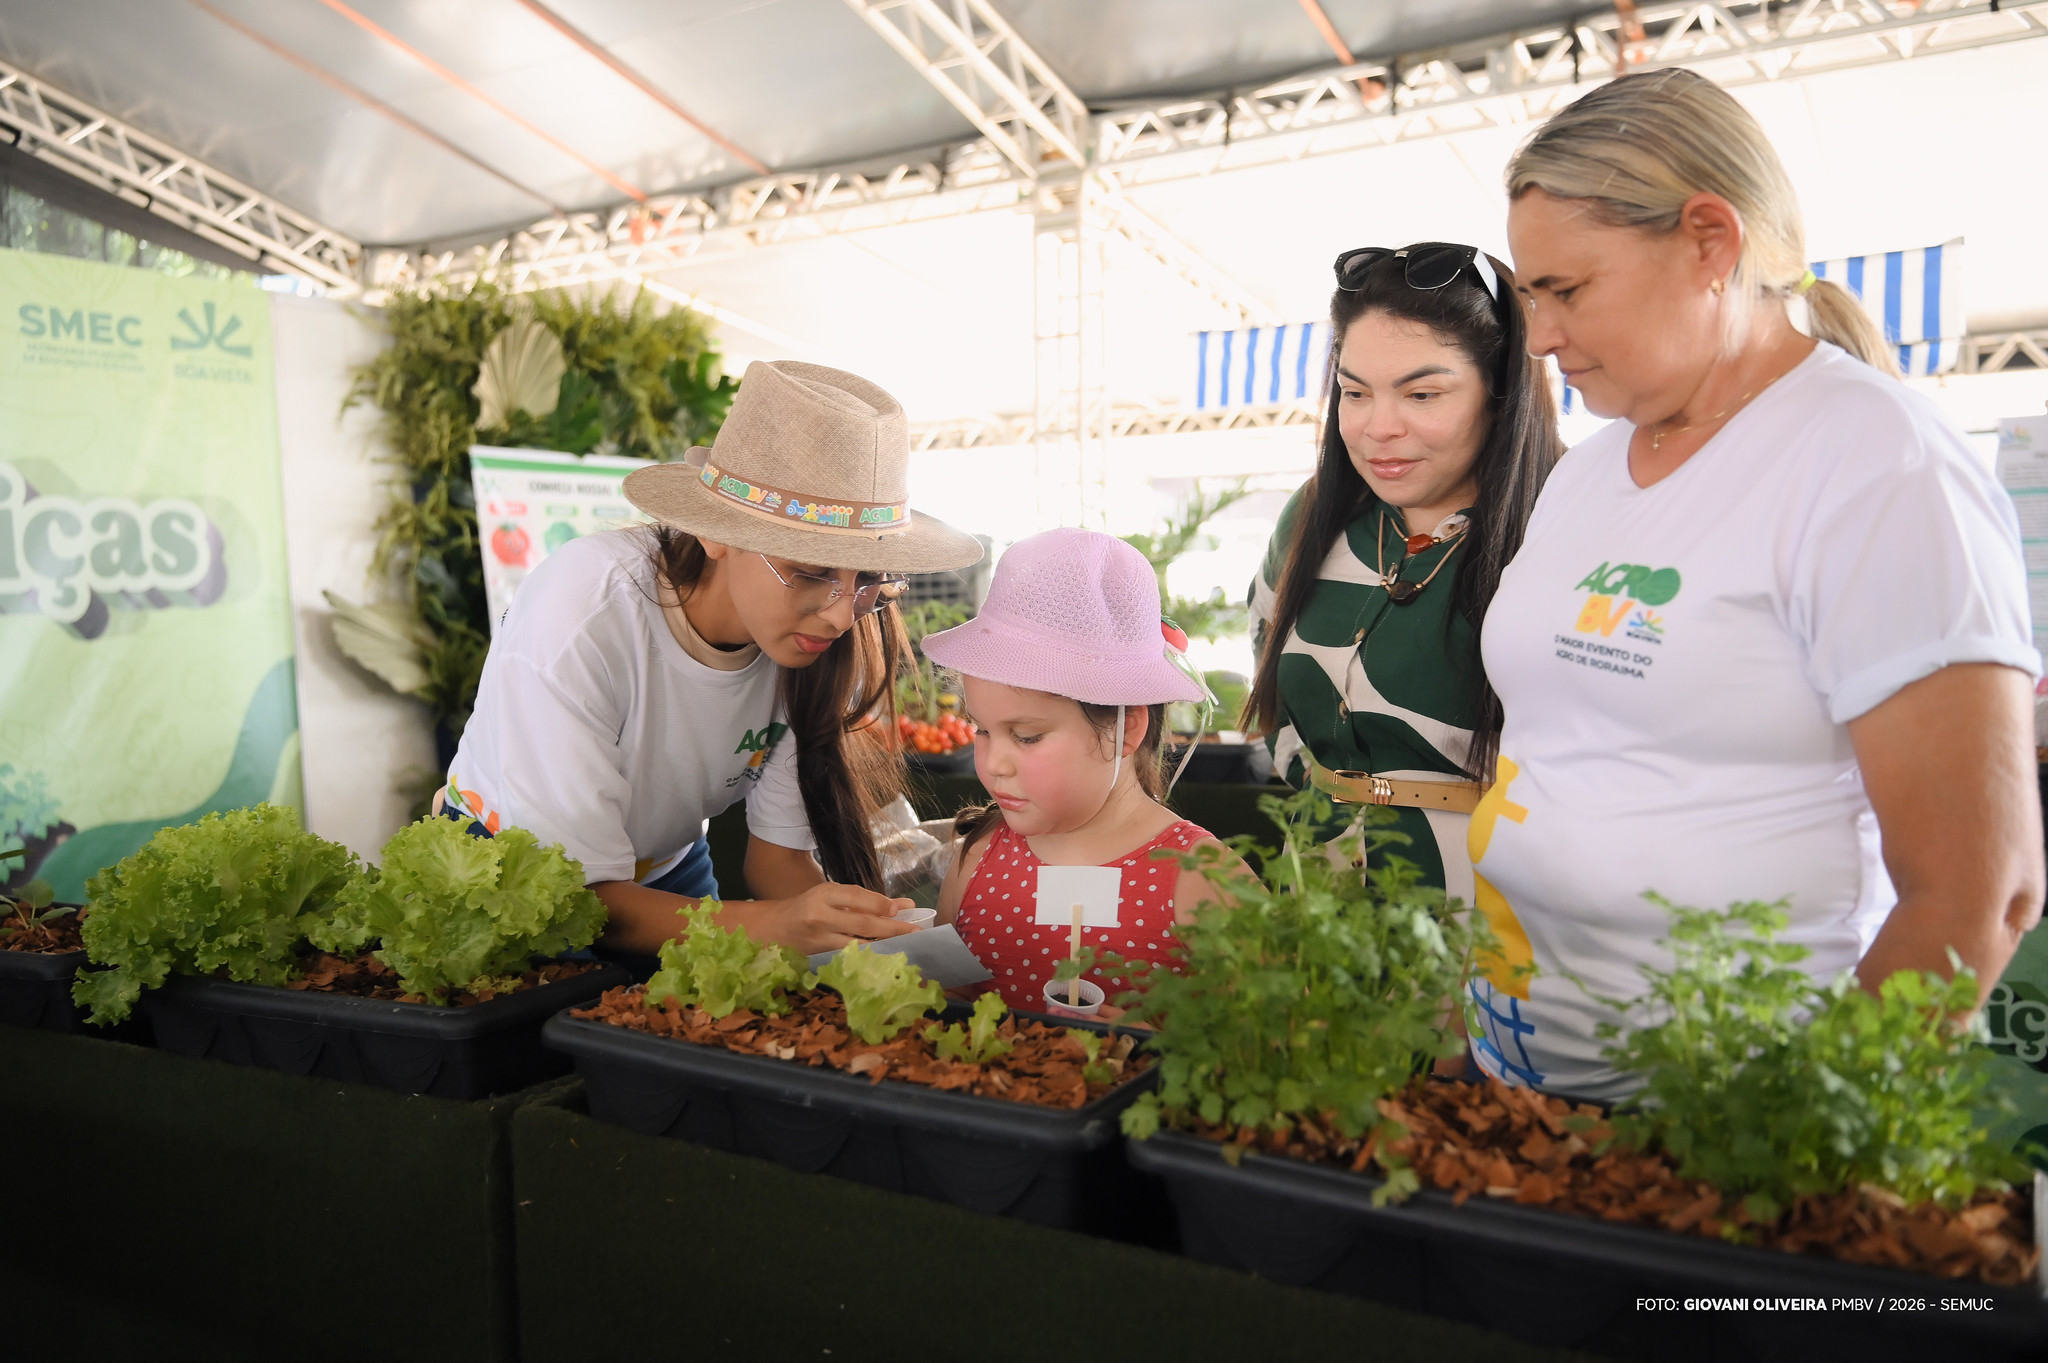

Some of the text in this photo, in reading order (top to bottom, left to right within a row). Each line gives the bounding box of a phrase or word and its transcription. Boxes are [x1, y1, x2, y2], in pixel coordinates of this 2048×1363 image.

[18, 303, 143, 348] SMEC
[1574, 561, 1681, 606] AGRO
[1574, 594, 1635, 638] BV
[1576, 654, 1588, 666] DE
[1590, 658, 1645, 679] RORAIMA
[1586, 642, 1631, 661] EVENTO
[1633, 653, 1653, 667] DO
